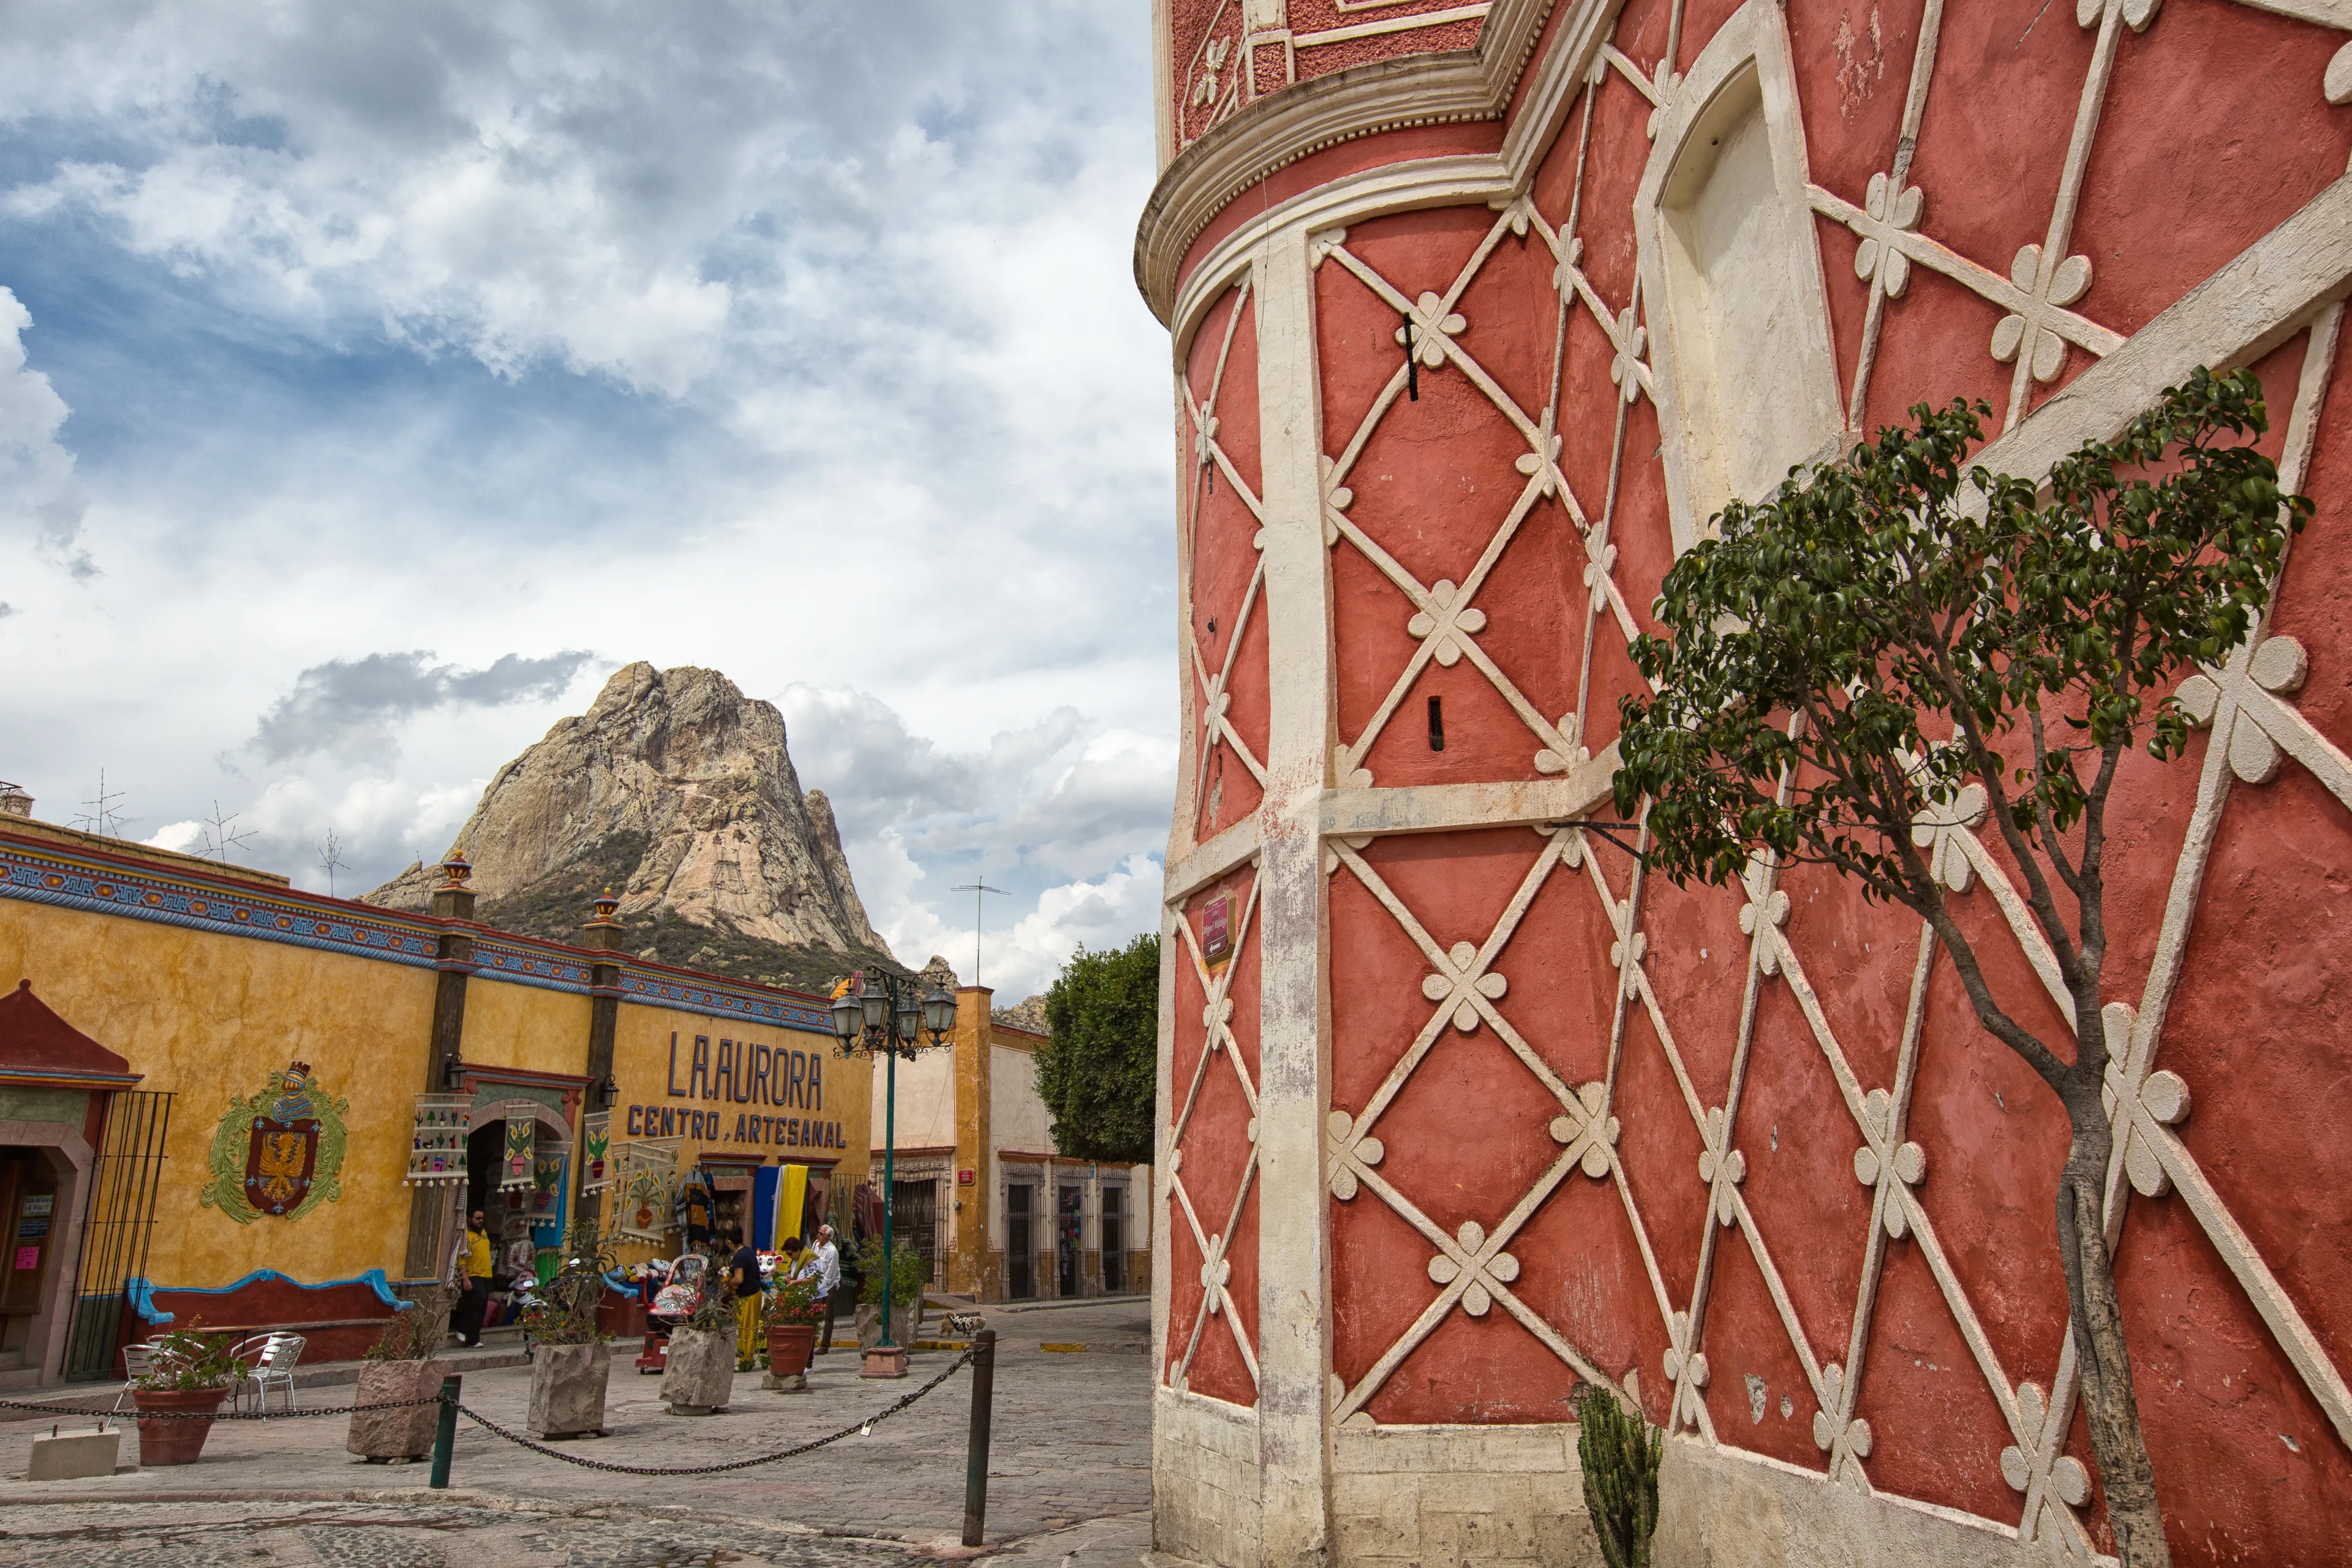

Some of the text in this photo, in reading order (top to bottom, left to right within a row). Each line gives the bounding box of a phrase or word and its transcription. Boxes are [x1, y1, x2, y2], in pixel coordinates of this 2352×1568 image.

[1203, 916, 1227, 936] Miguel Hidalgo
[714, 1038, 821, 1110] AURORA
[734, 1114, 846, 1148] ARTESANAL
